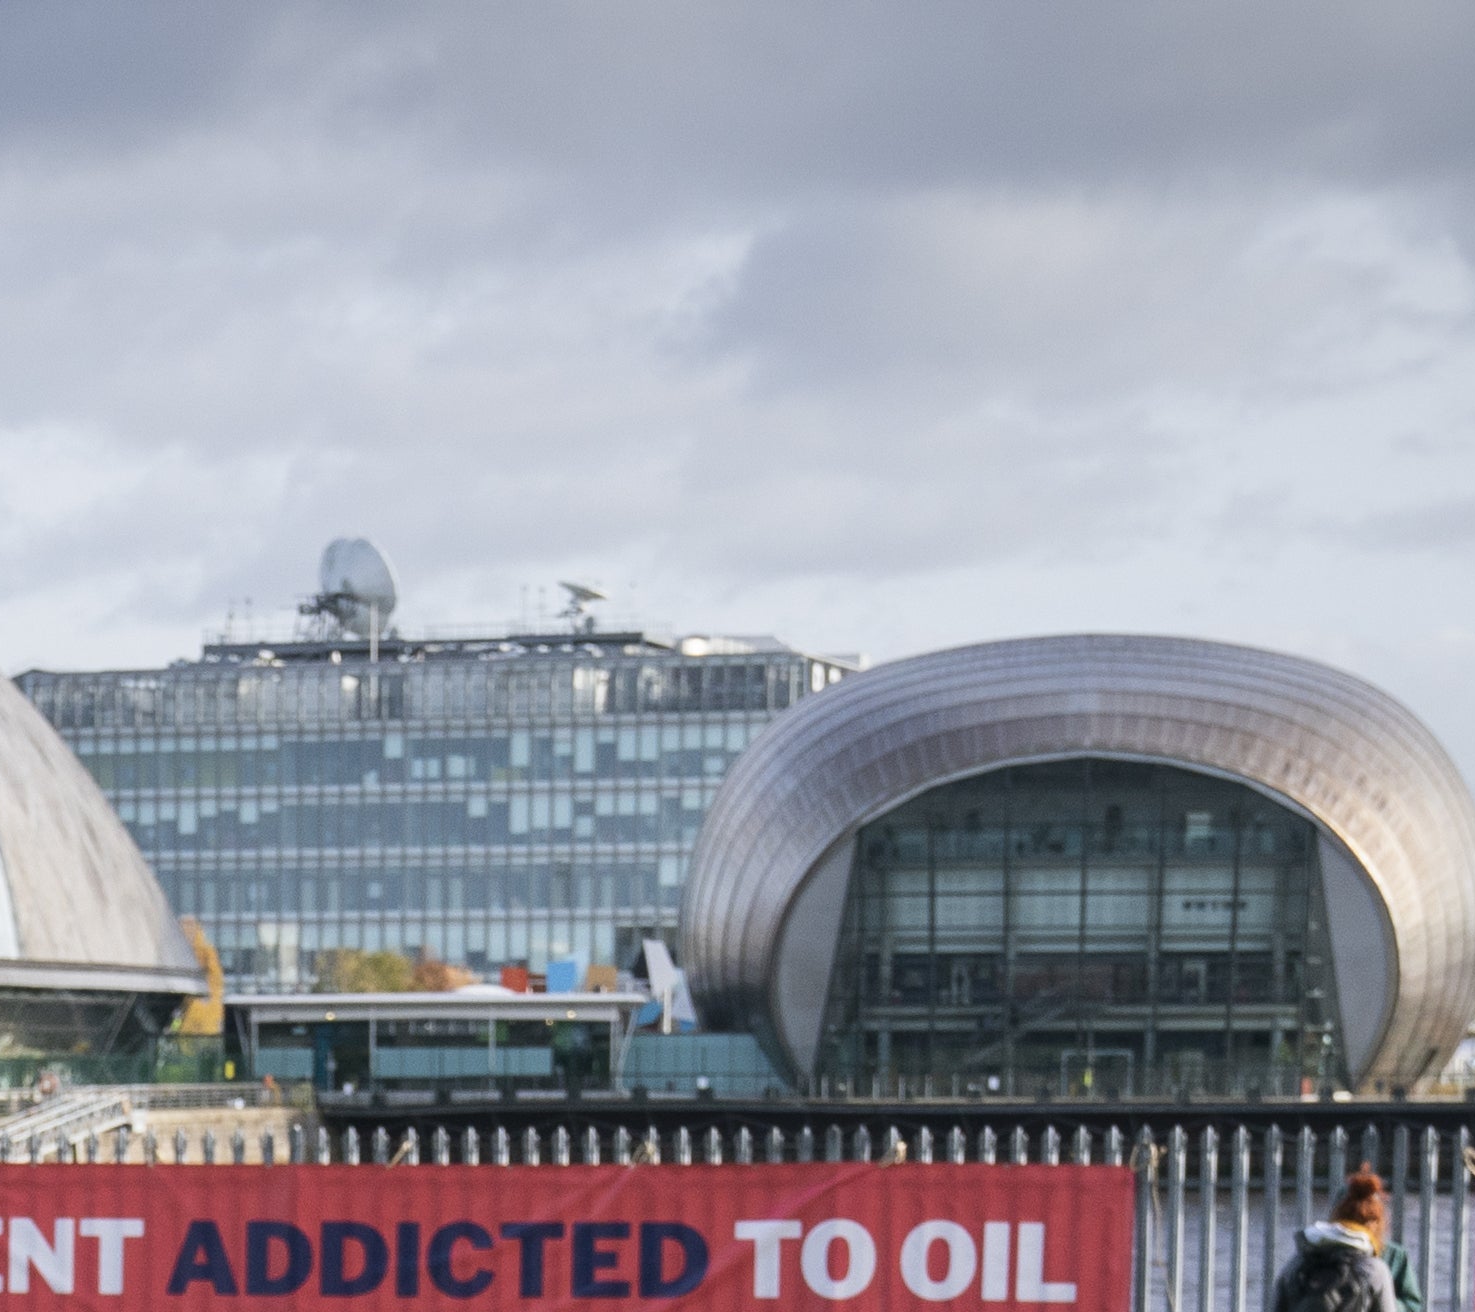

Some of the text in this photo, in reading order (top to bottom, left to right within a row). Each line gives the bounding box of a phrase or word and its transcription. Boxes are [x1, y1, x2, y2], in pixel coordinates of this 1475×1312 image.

[167, 1219, 710, 1300] ADDICTED
[735, 1218, 877, 1300] TO
[900, 1220, 1077, 1302] OIL
